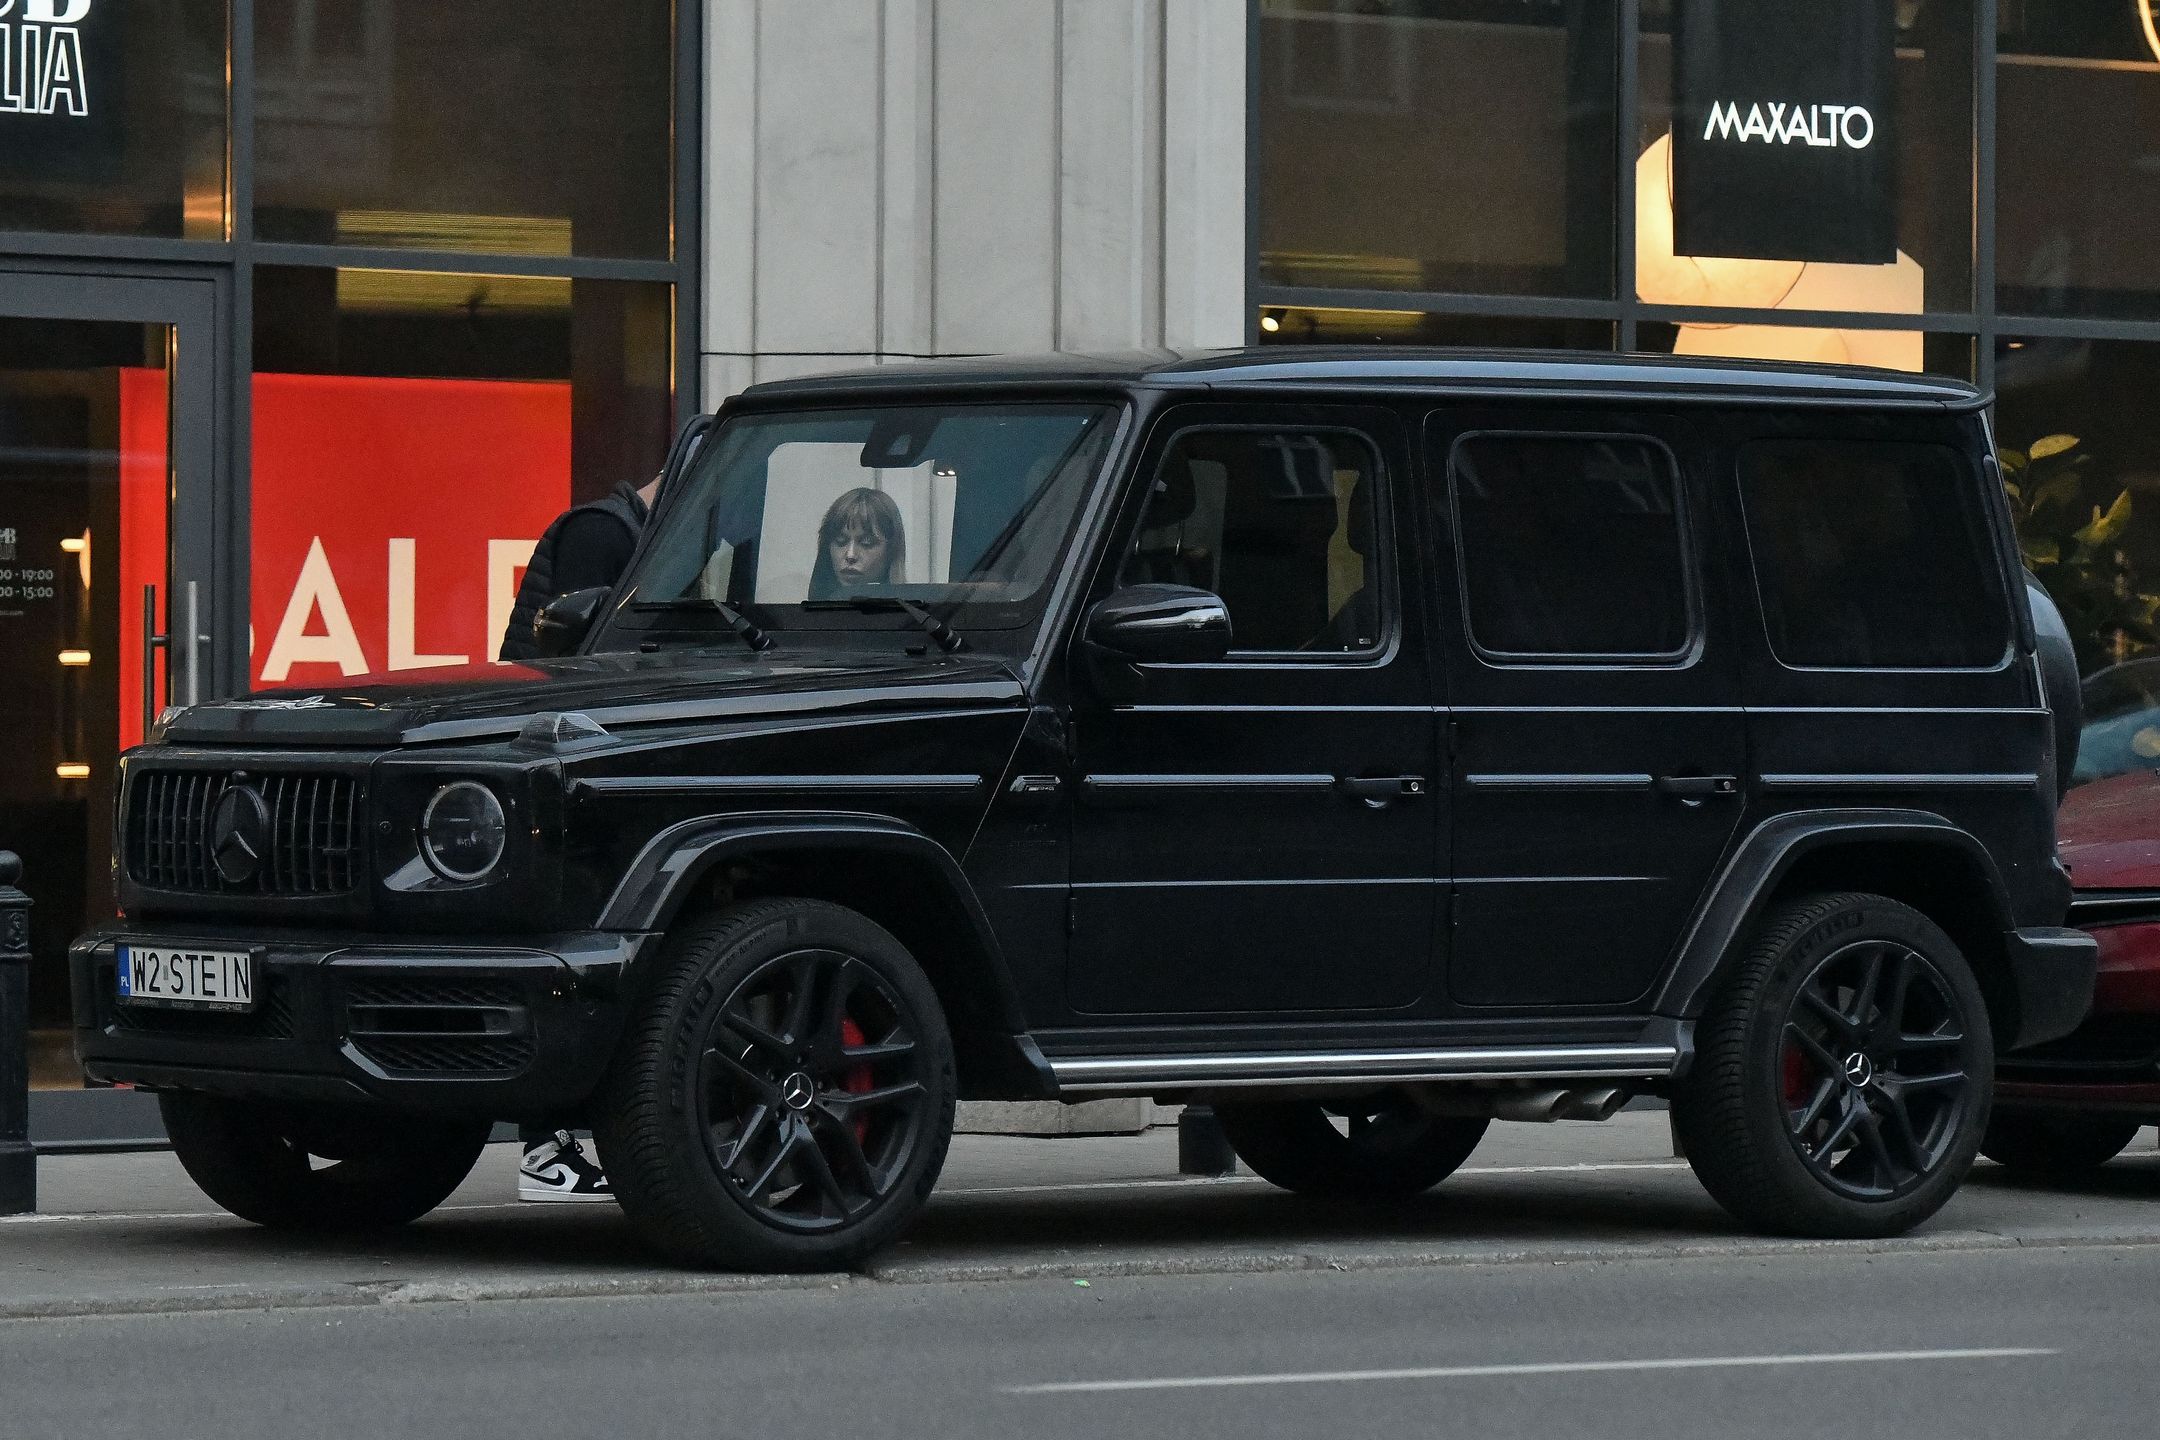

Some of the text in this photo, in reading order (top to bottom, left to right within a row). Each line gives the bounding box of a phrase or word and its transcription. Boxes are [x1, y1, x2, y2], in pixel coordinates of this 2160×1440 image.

[1703, 100, 1874, 149] MAXALTO
[22, 586, 54, 600] 15:00
[249, 535, 540, 681] AL
[120, 976, 130, 987] PL
[132, 951, 249, 999] W2 STEIN
